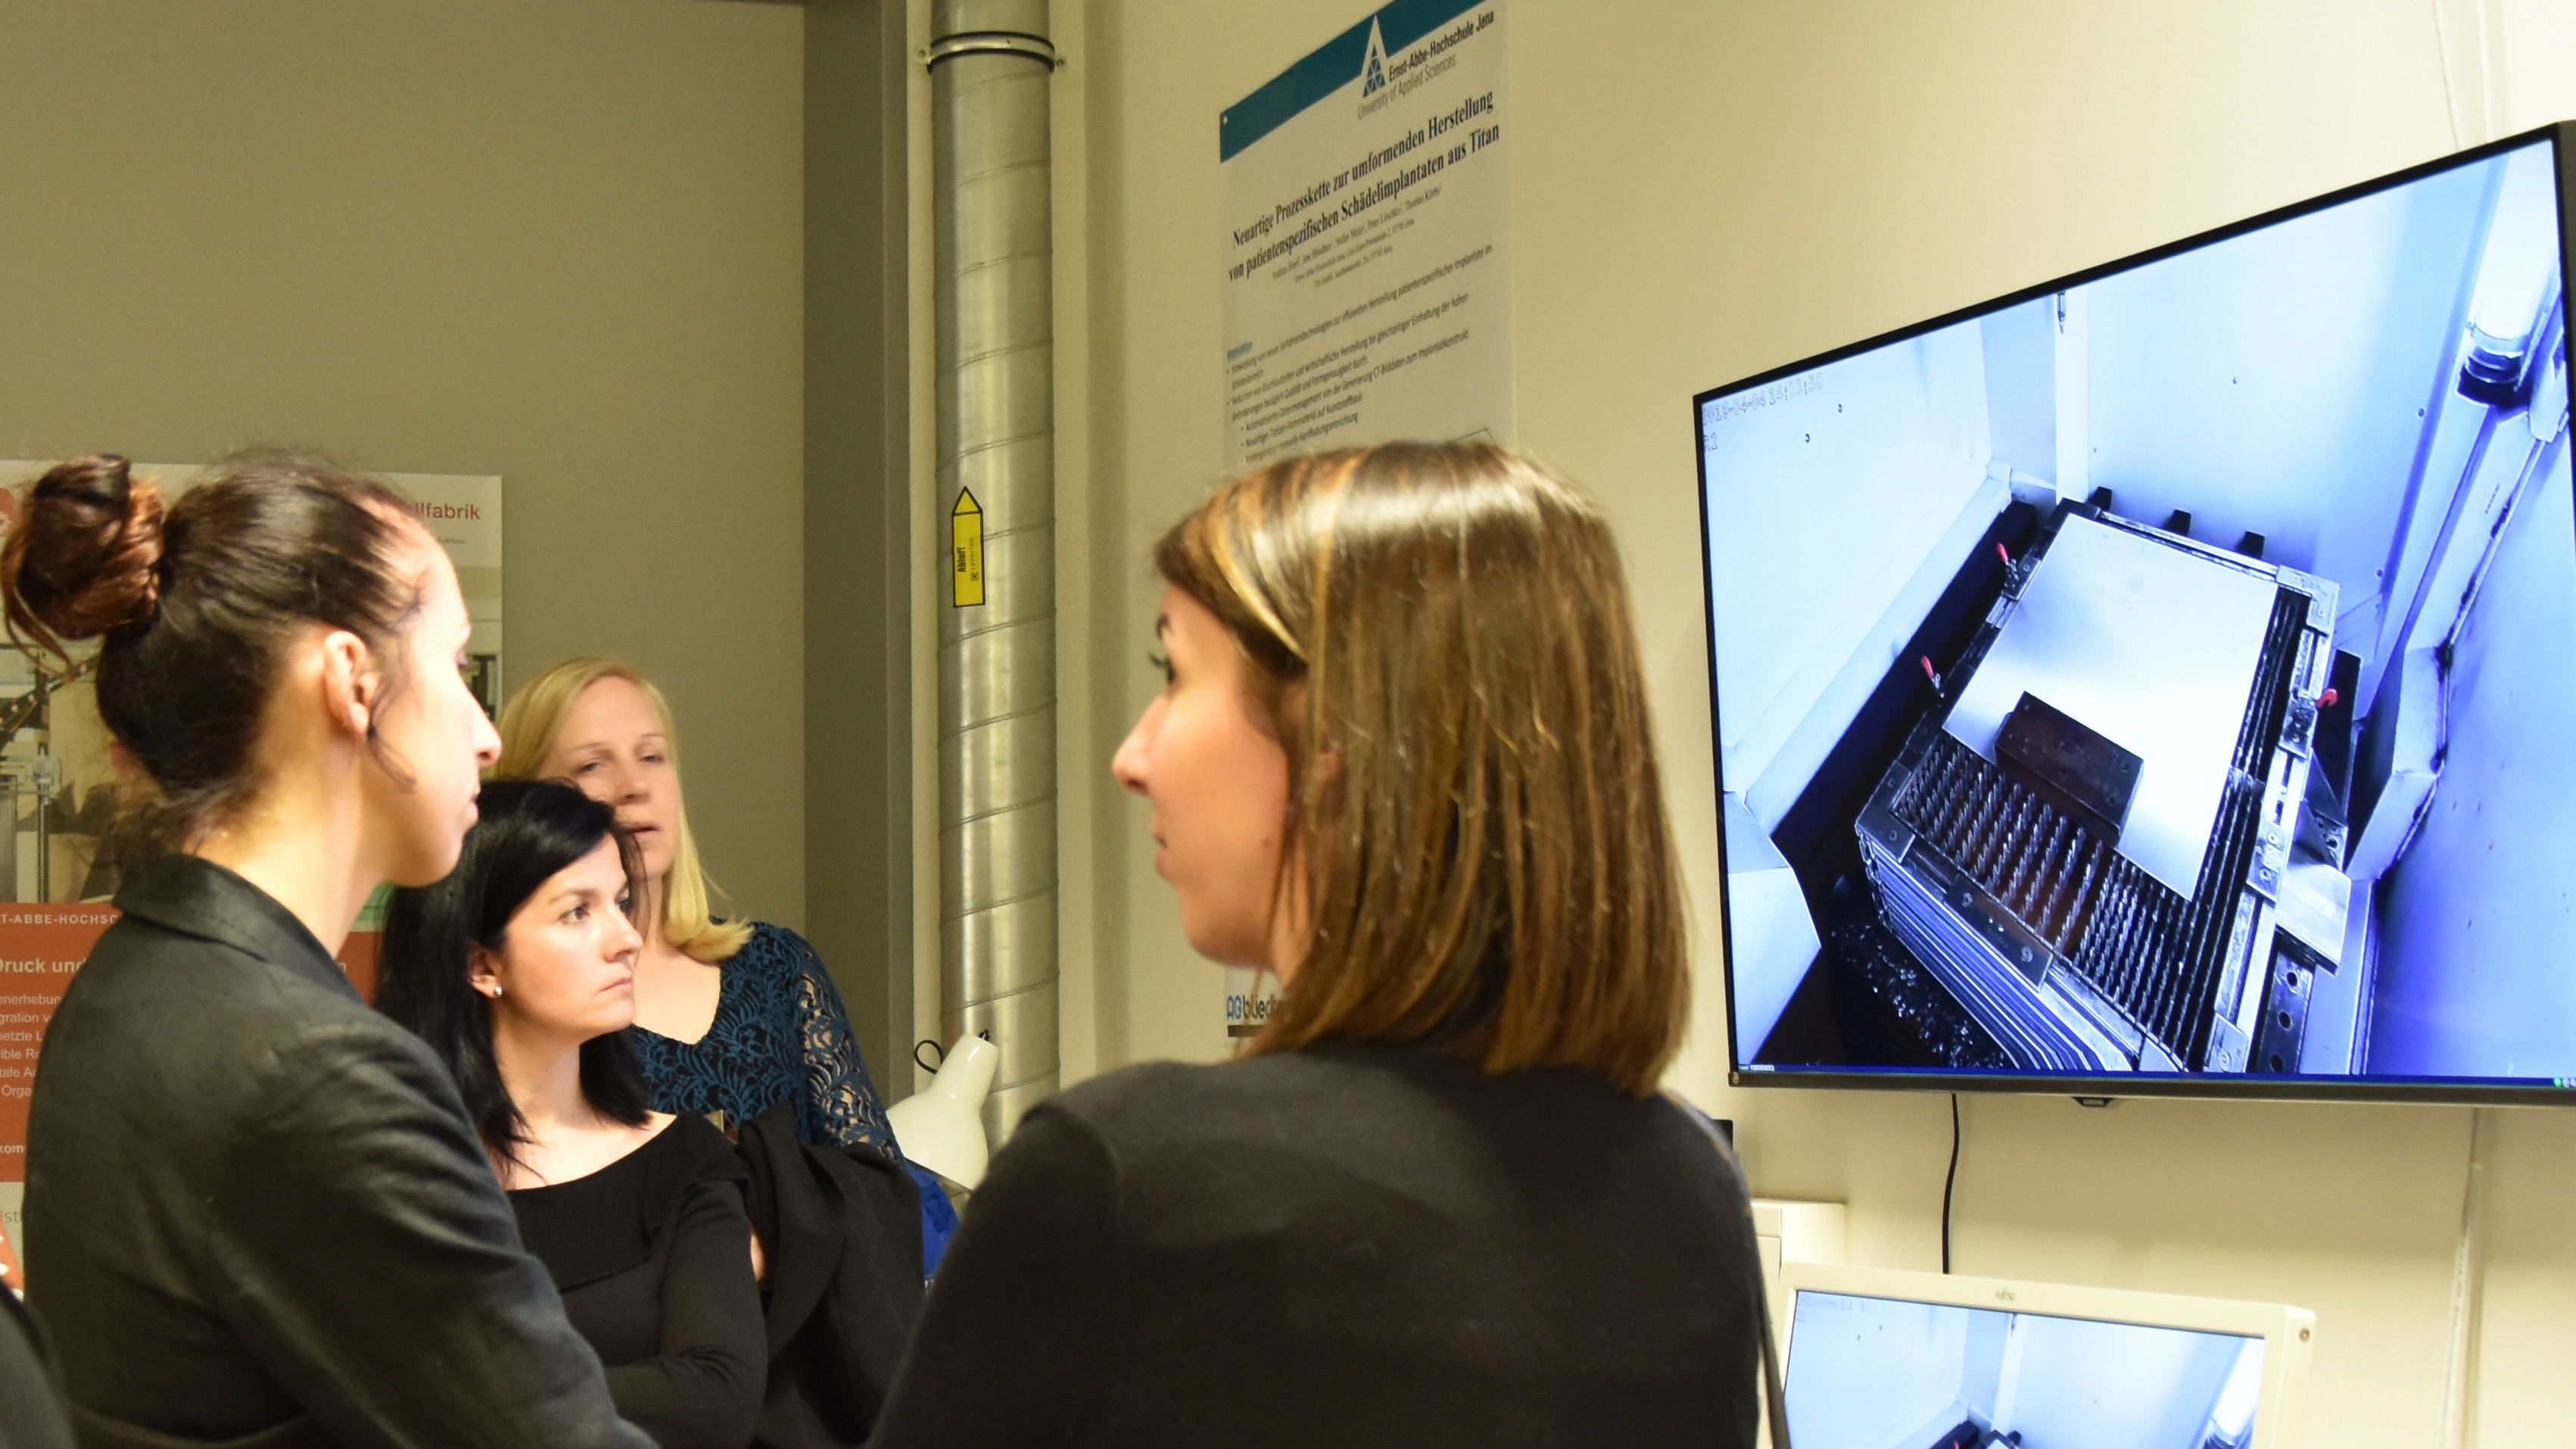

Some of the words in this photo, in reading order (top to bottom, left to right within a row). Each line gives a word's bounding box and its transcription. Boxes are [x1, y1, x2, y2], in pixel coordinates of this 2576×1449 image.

[1389, 21, 1474, 82] Ernst-Abbe-Hochschule
[1476, 11, 1494, 32] Jena
[1358, 92, 1389, 120] University
[1390, 84, 1397, 102] of
[1398, 71, 1424, 99] Applied
[1425, 55, 1457, 83] Sciences
[1229, 263, 1244, 282] von
[1247, 209, 1339, 279] patientenspezifischen
[1341, 154, 1444, 221] Schädelimplantaten
[1447, 142, 1466, 167] aus
[1469, 124, 1500, 154] Titan
[1233, 214, 1274, 250] Neuartige
[1276, 180, 1331, 225] Prozesskette
[1333, 170, 1349, 193] zur
[1352, 129, 1425, 181] umformenden
[1428, 92, 1494, 141] Herstellung
[957, 547, 967, 573] Abluft
